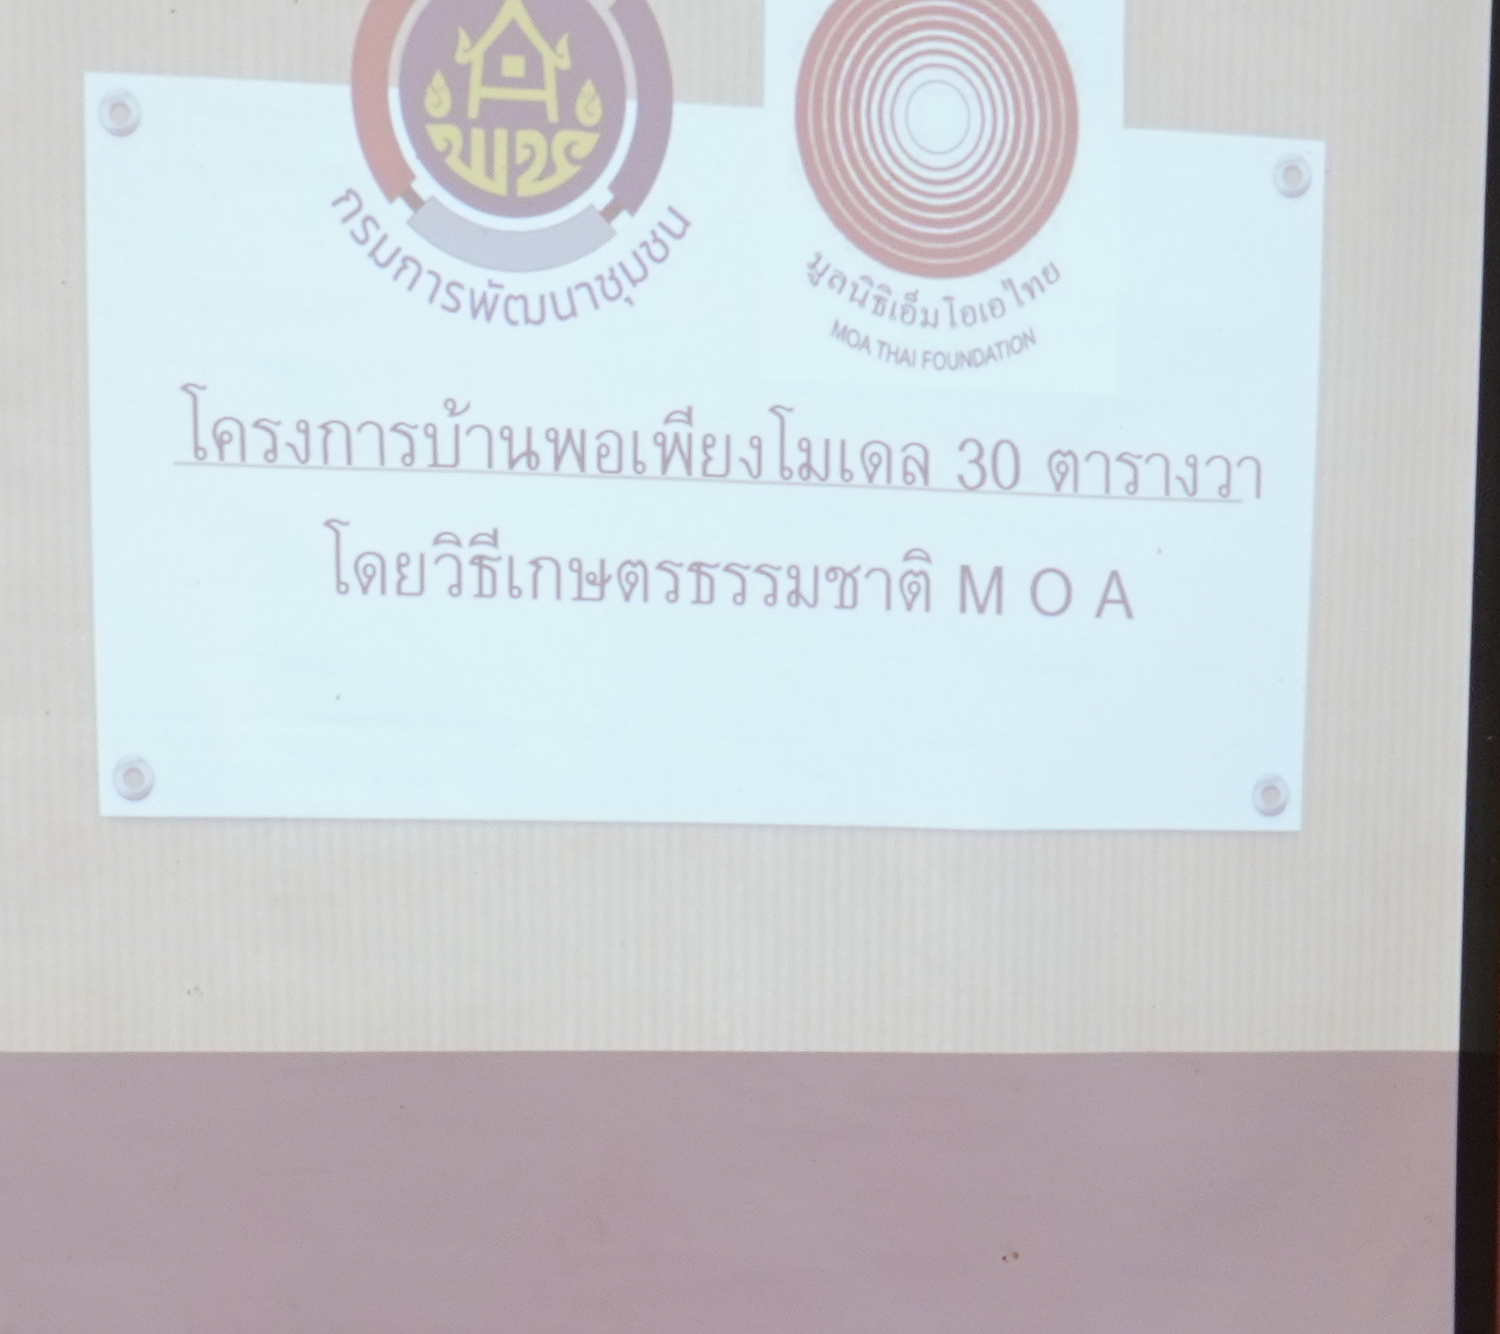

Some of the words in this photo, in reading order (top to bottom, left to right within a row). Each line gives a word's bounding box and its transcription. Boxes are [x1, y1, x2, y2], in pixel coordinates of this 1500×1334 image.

[332, 187, 691, 326] กรมการพัฒนาชุมชน
[830, 319, 872, 355] MOA
[877, 339, 916, 368] THAI
[922, 327, 1037, 370] FOUNDATION
[181, 383, 930, 487] โครงการบ้านพอเพียงโมเดล
[958, 438, 1021, 492] 30
[1048, 449, 1262, 499] ตารางวา
[324, 519, 931, 613] โดยวิธีเกษตรธรรมชาติ
